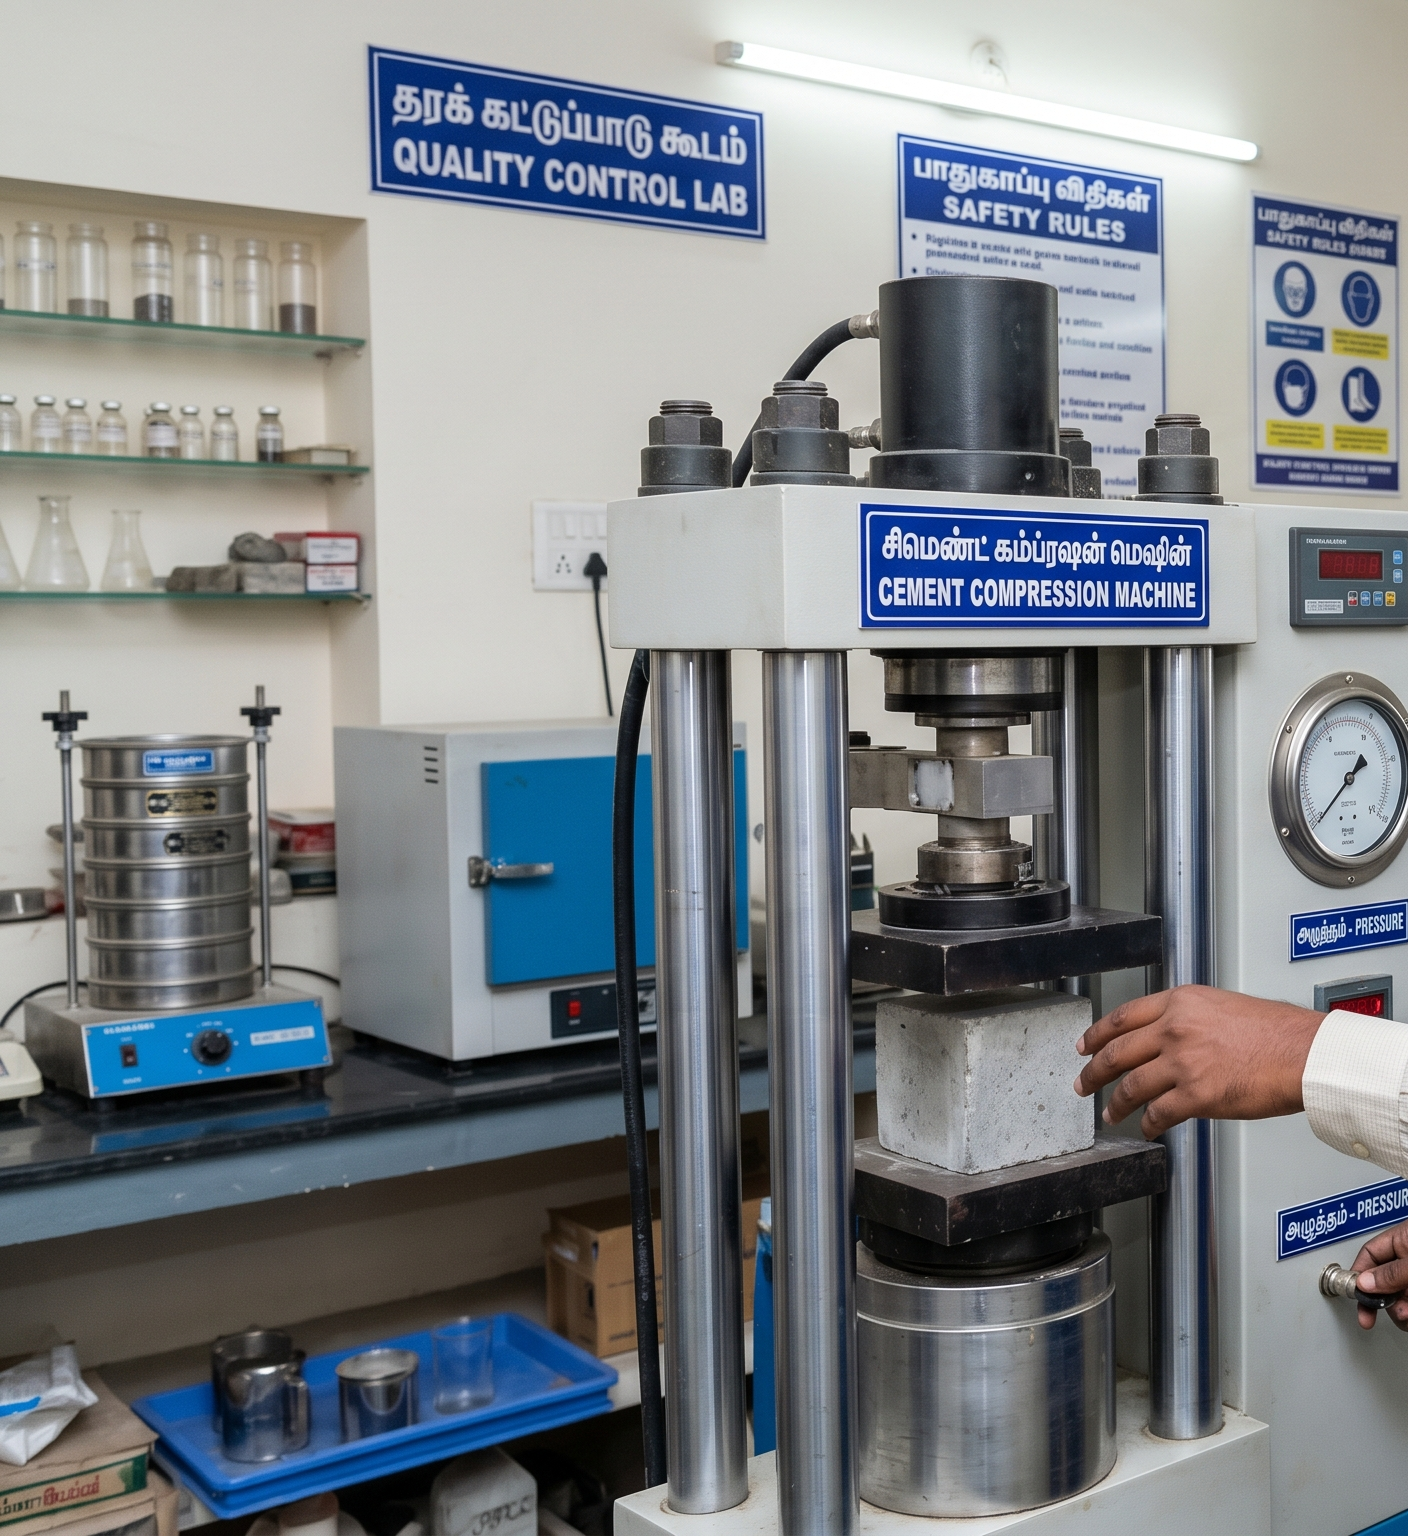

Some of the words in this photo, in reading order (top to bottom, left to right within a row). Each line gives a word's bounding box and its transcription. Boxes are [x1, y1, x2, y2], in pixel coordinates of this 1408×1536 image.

[392, 82, 474, 127] தரக்
[481, 97, 654, 160] கட்டுப்பாடு
[660, 124, 748, 166] கூடம்
[392, 137, 536, 188] QUALITY
[543, 158, 686, 209] CONTROL
[693, 179, 749, 217] LAB
[913, 155, 1051, 205] பாதுகாப்பு
[1055, 175, 1152, 214] விதிகள்
[943, 195, 1042, 231] SAFETY
[1048, 211, 1127, 243] RULES
[1266, 229, 1310, 248] SAFETY
[882, 526, 990, 563] சிமெண்ட்
[994, 529, 1107, 571] கம்ப்ரஷன்
[1111, 534, 1193, 573] மெஷின்
[878, 576, 965, 607] CEMENT
[969, 578, 1109, 608] COMPRESSION
[1115, 580, 1197, 609] MACHINE
[1355, 912, 1404, 936] PRESSURE
